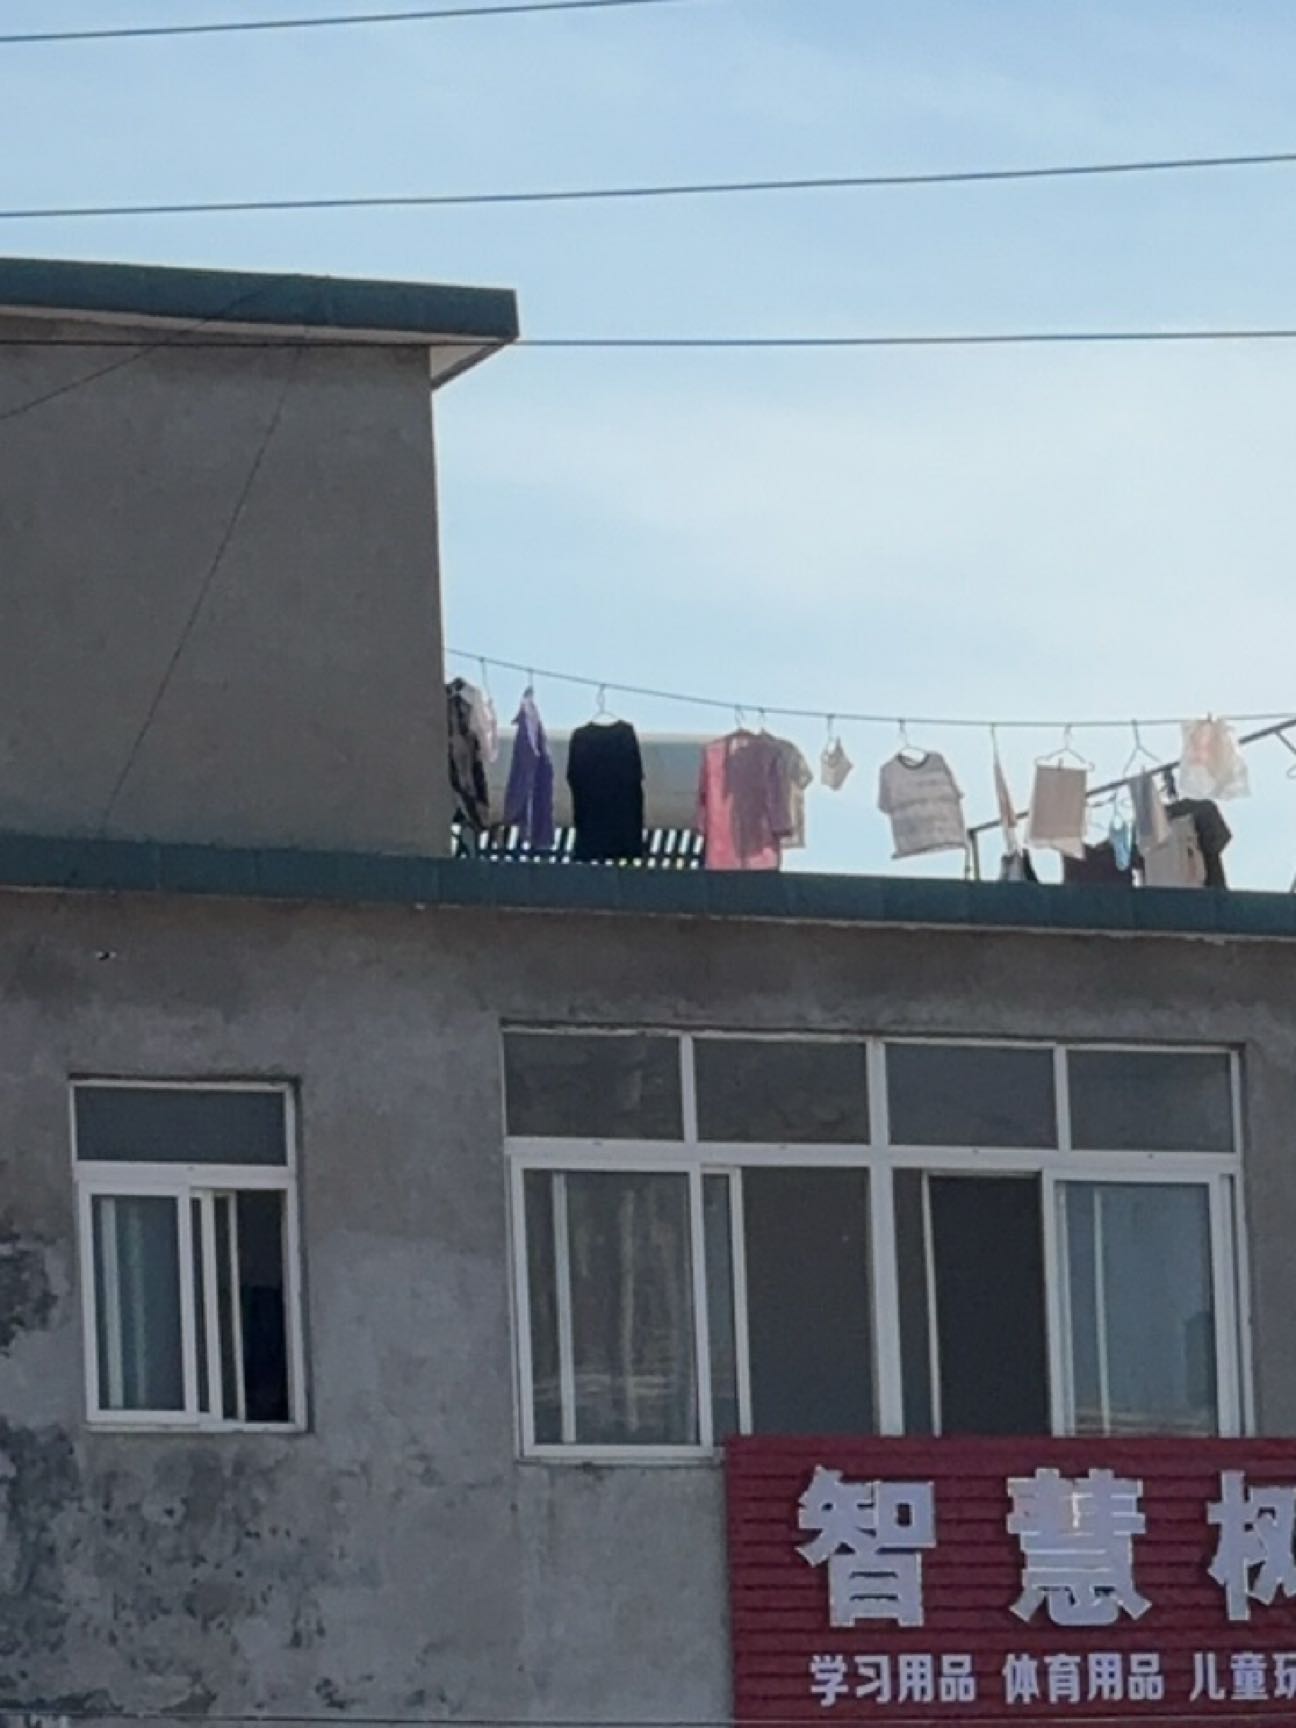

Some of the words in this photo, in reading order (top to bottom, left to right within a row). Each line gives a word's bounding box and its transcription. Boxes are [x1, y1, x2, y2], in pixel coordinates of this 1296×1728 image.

[809, 1654, 976, 1706] 学习用品
[1002, 1652, 1165, 1703] 体育用品
